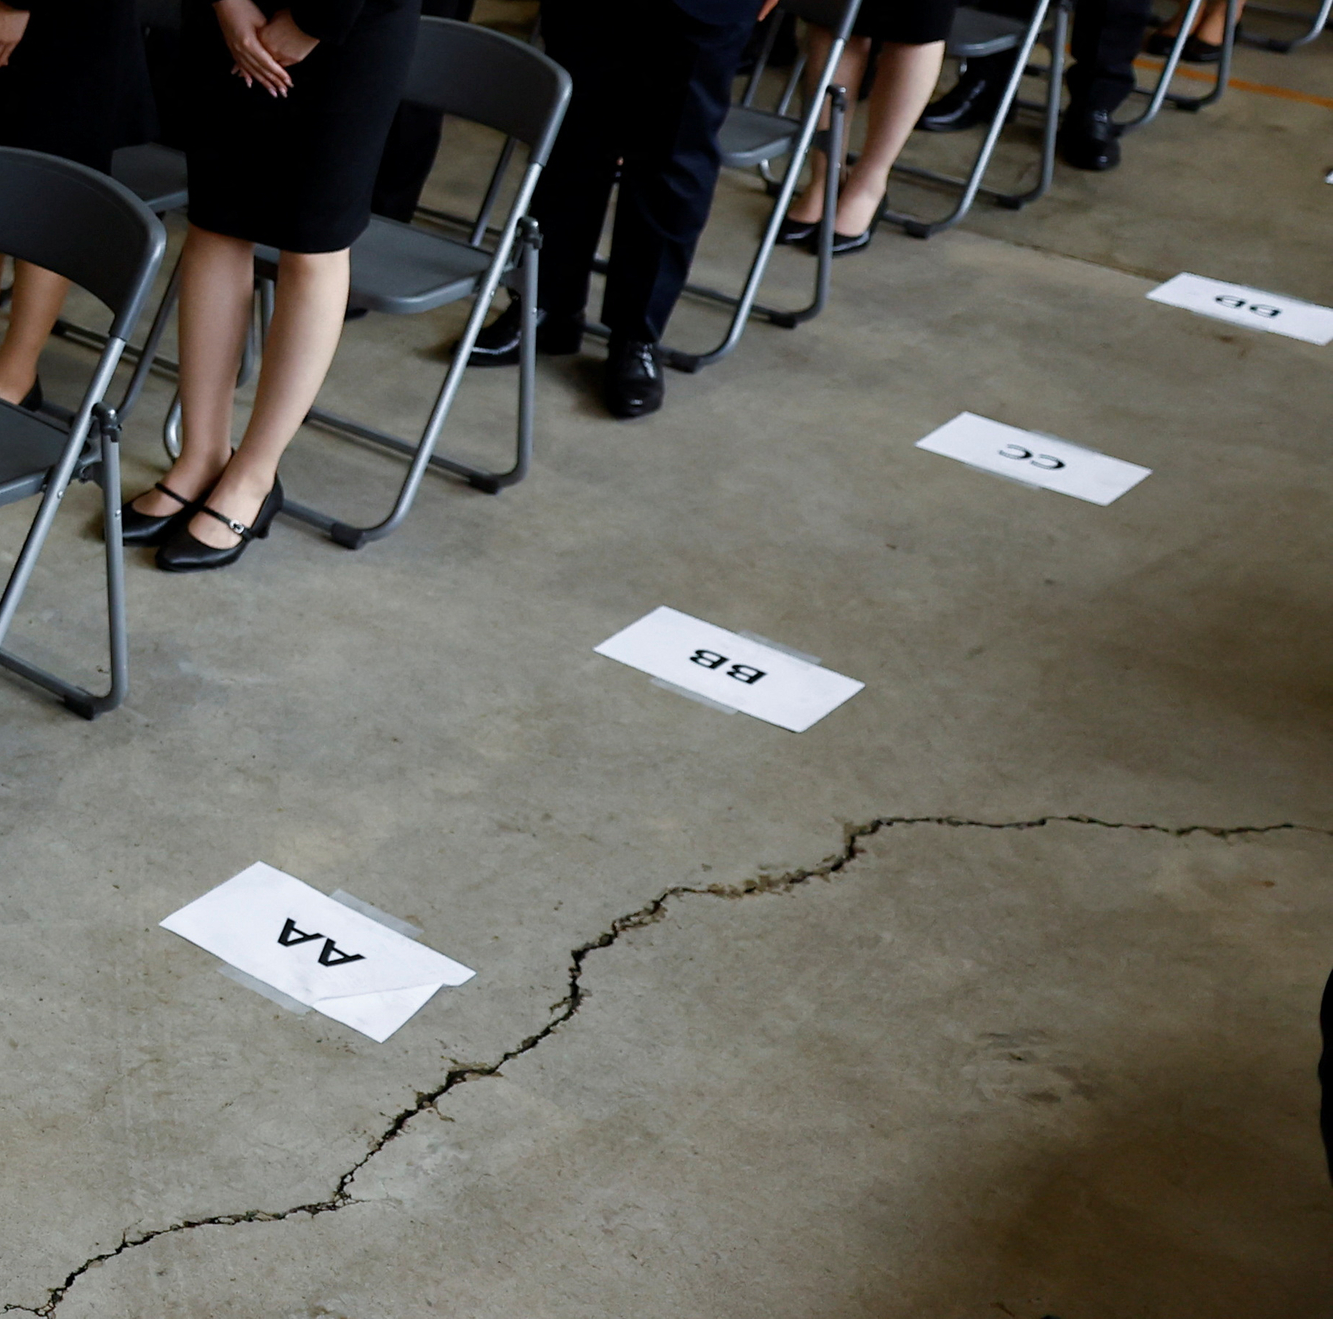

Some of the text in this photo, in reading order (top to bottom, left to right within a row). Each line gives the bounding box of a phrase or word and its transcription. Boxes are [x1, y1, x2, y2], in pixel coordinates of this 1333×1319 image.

[1214, 295, 1282, 319] DD
[999, 443, 1066, 470] CC
[689, 648, 768, 685] BB
[277, 917, 367, 968] AA
